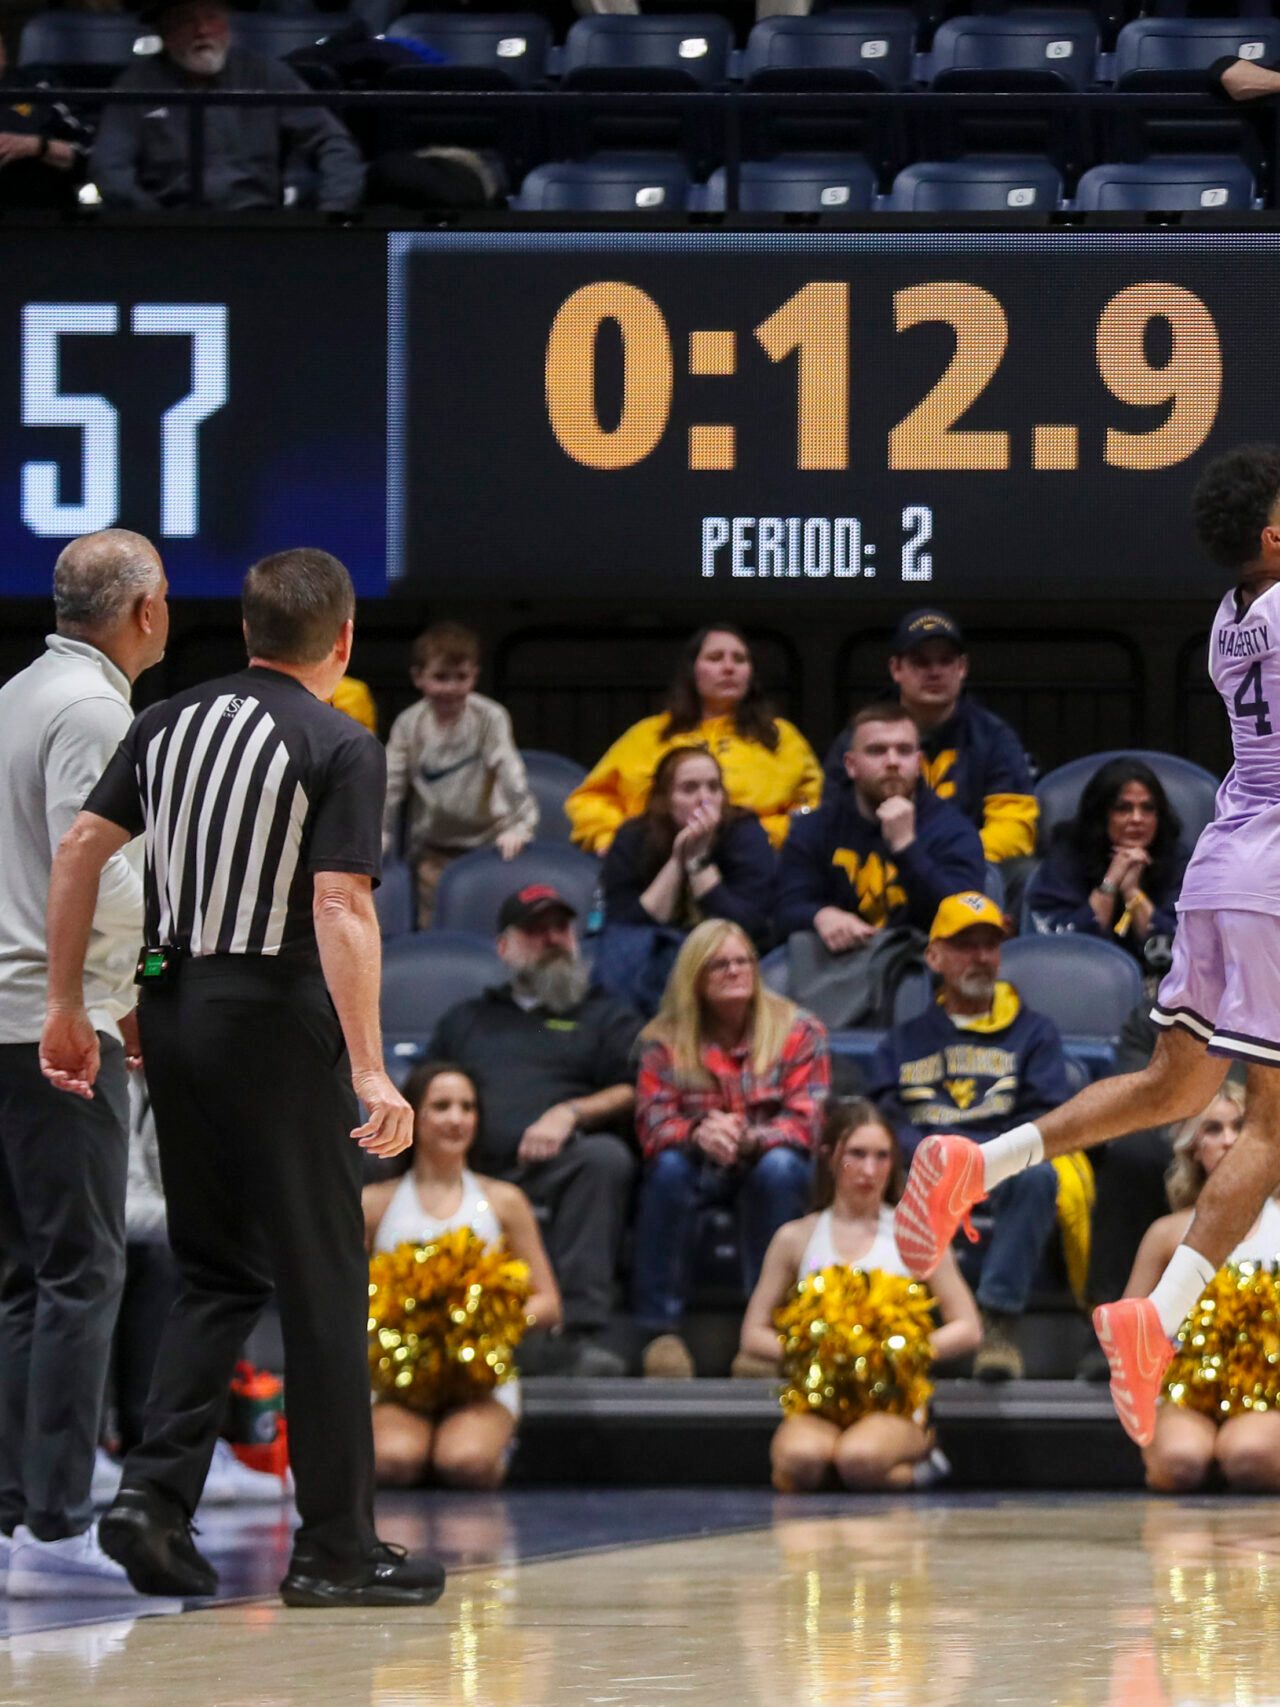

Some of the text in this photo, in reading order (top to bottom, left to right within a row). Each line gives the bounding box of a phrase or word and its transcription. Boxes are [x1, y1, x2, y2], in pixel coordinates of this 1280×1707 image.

[545, 281, 1222, 471] 0:12.9
[21, 302, 229, 538] 57
[702, 506, 933, 582] PERIOD: 2
[1218, 625, 1270, 657] HAGERTY
[1234, 661, 1273, 737] 4
